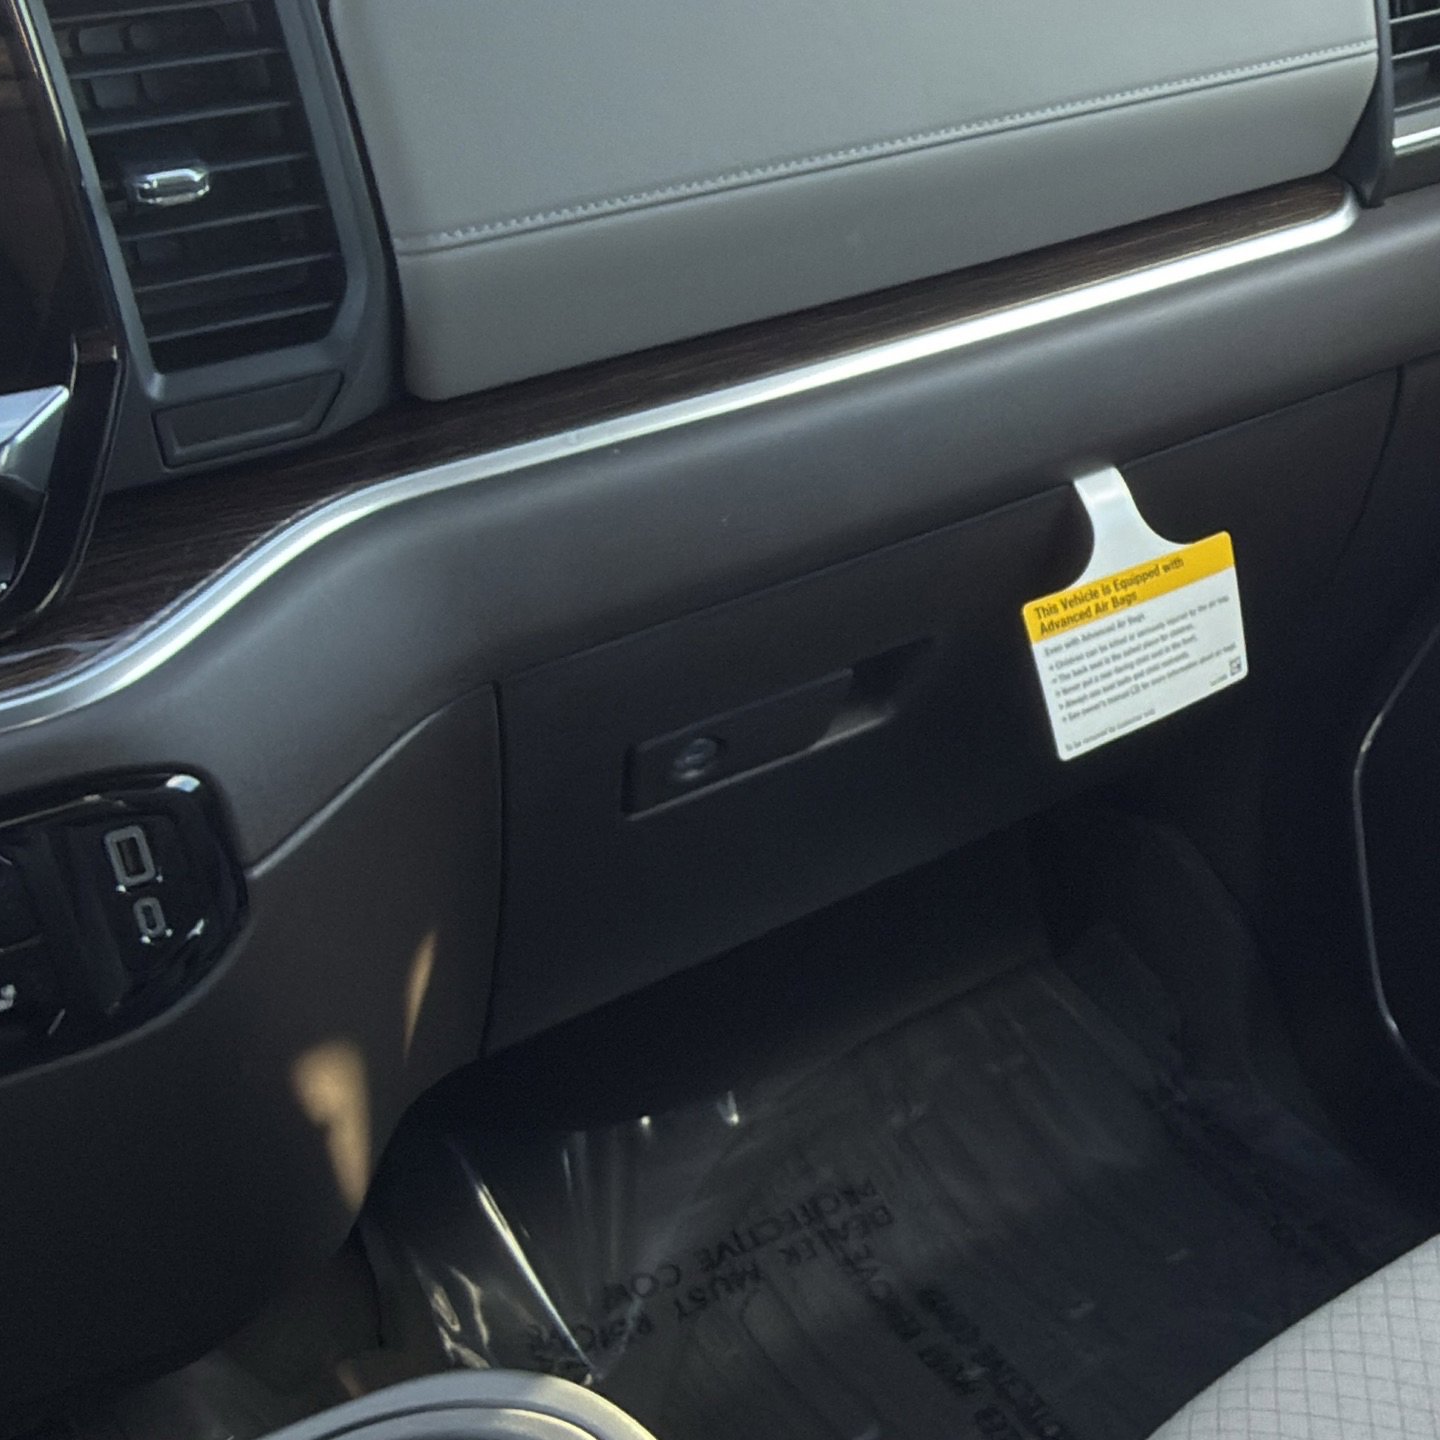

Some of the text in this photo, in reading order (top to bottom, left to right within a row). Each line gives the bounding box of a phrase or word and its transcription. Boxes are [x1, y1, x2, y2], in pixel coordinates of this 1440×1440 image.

[1036, 559, 1183, 620] This Vehicle is Equipped with
[1041, 592, 1138, 636] Advanced Air Bags
[1081, 624, 1115, 642] Advanced
